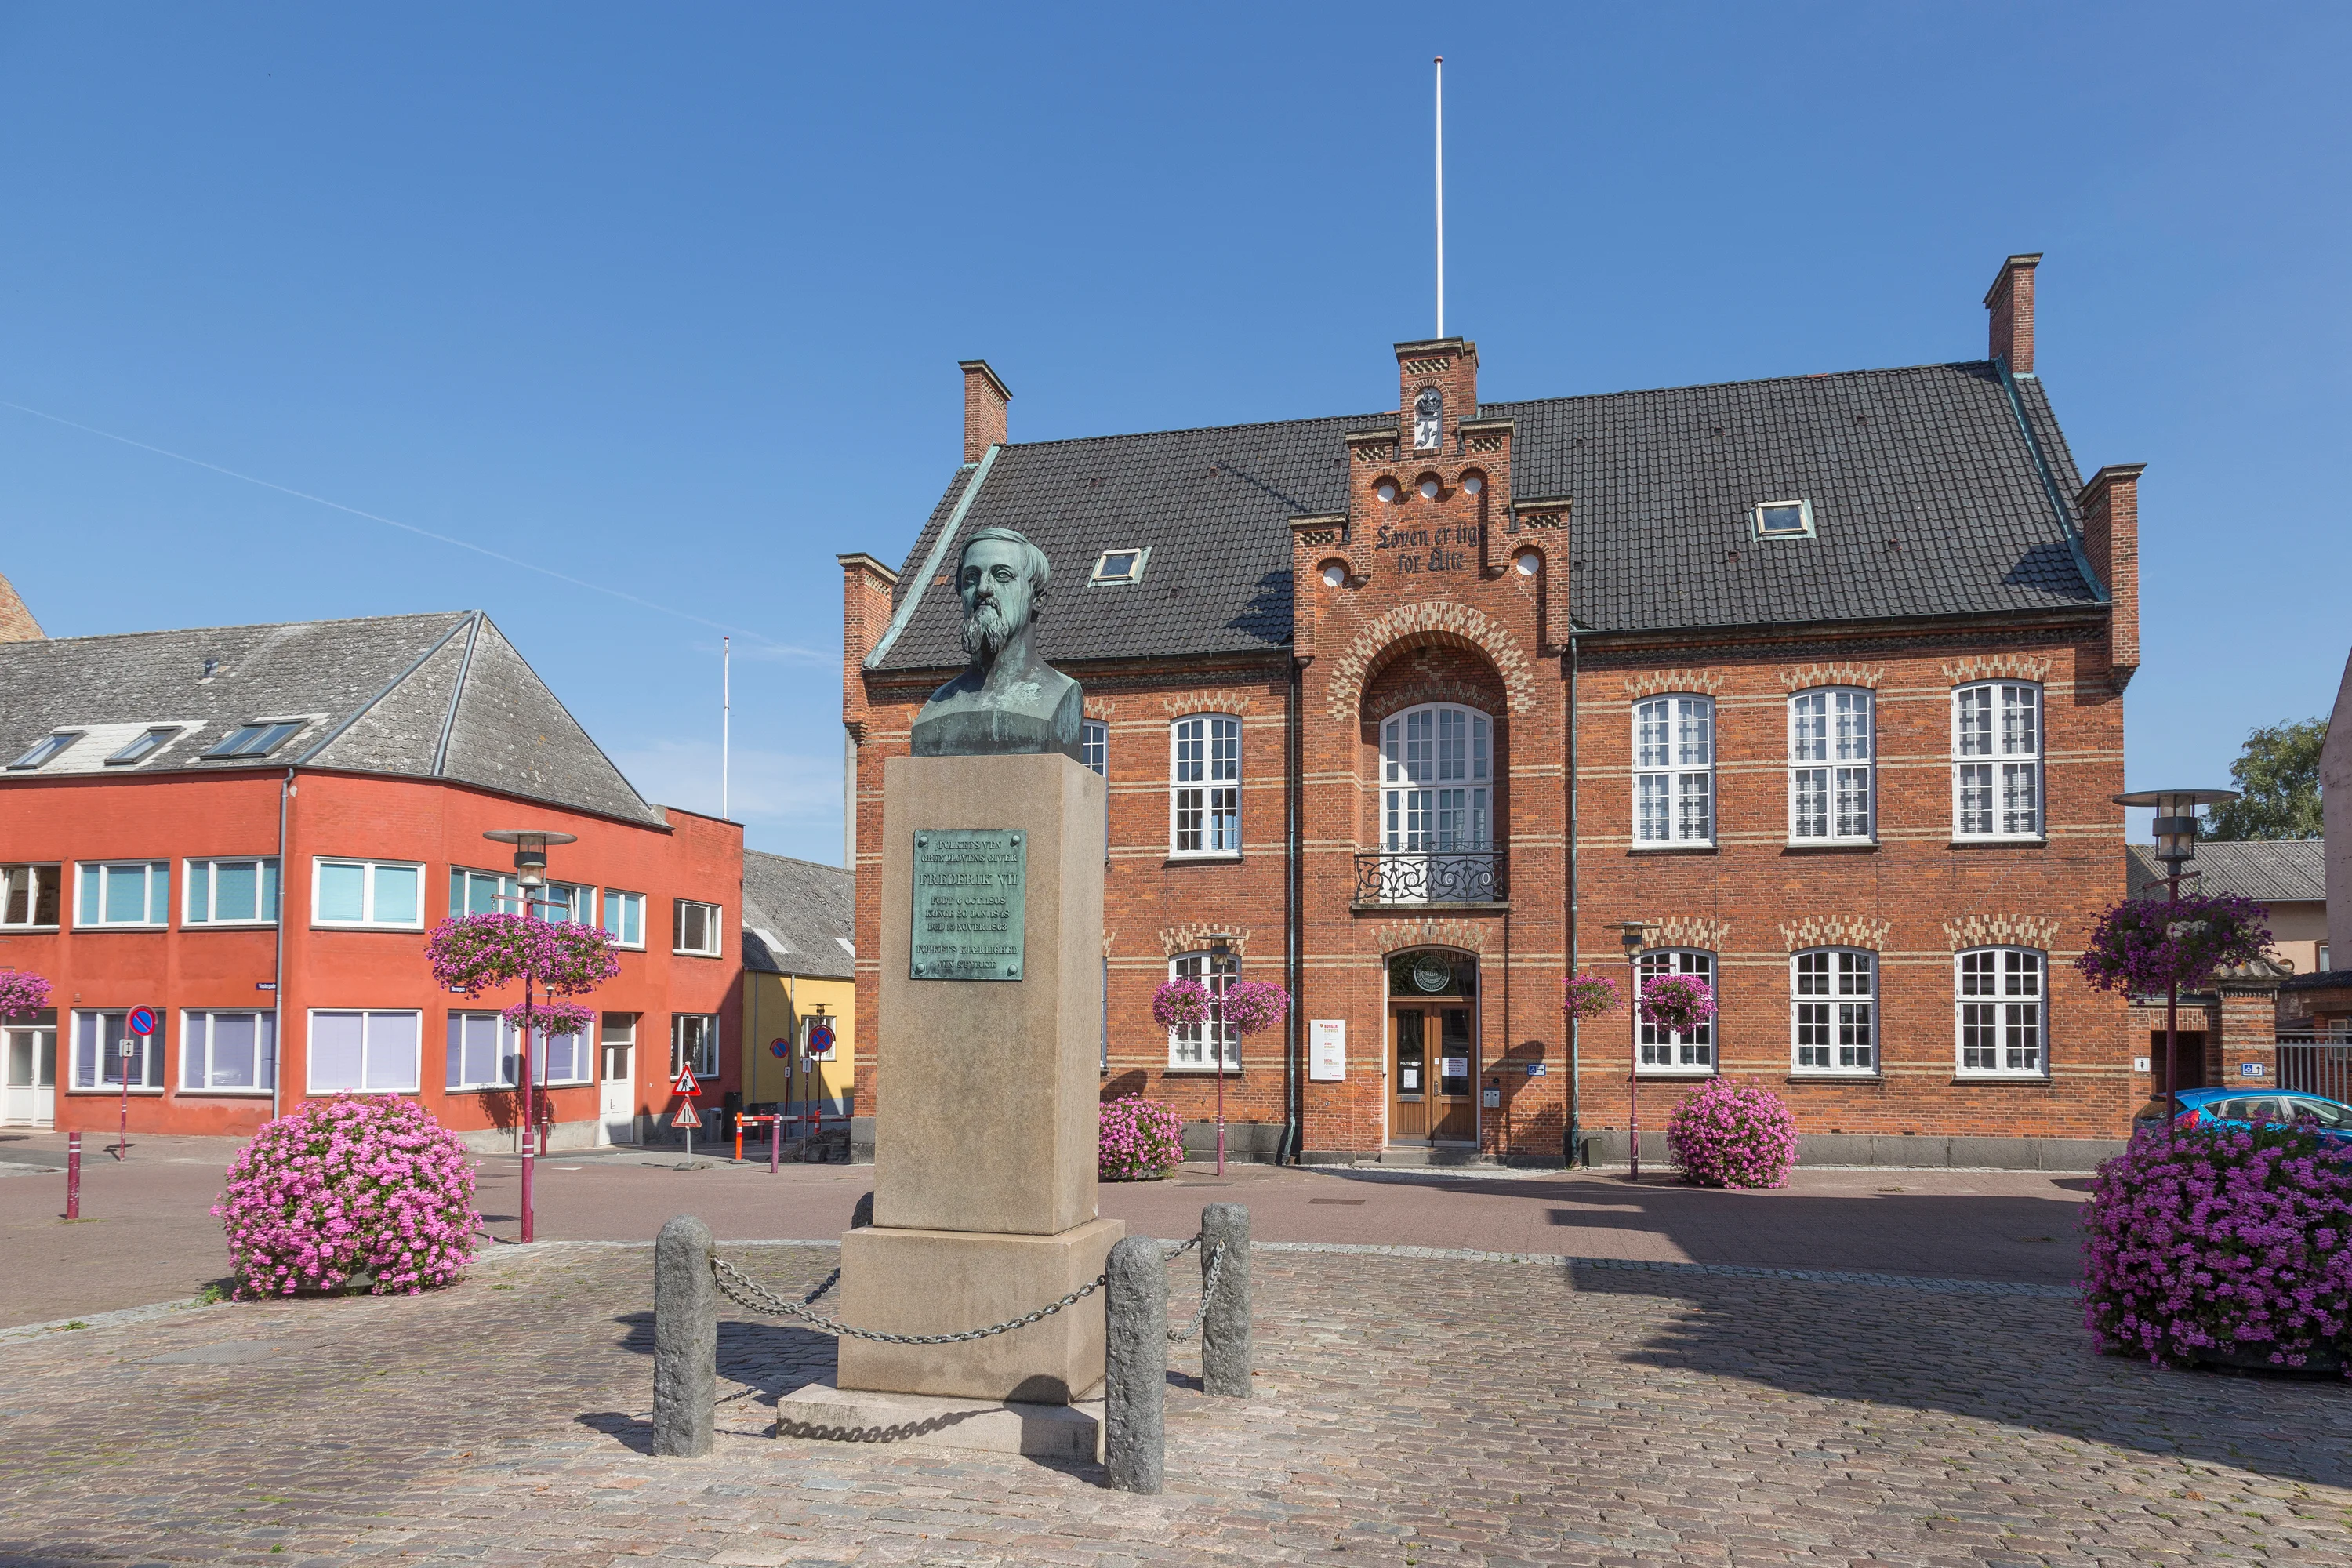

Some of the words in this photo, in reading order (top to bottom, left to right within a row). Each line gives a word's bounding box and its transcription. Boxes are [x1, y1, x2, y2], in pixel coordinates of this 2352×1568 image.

[1434, 528, 1450, 545] er
[1457, 523, 1477, 547] lig
[1398, 553, 1421, 574] for
[1428, 548, 1464, 572] Alle
[982, 840, 1001, 849] VEN
[921, 854, 985, 862] GRUNDLOVENS
[987, 854, 1018, 862] GIVER
[919, 874, 993, 885] FREDERIK
[998, 873, 1018, 885] VII
[925, 909, 954, 918] KONGE
[956, 909, 968, 918] 20
